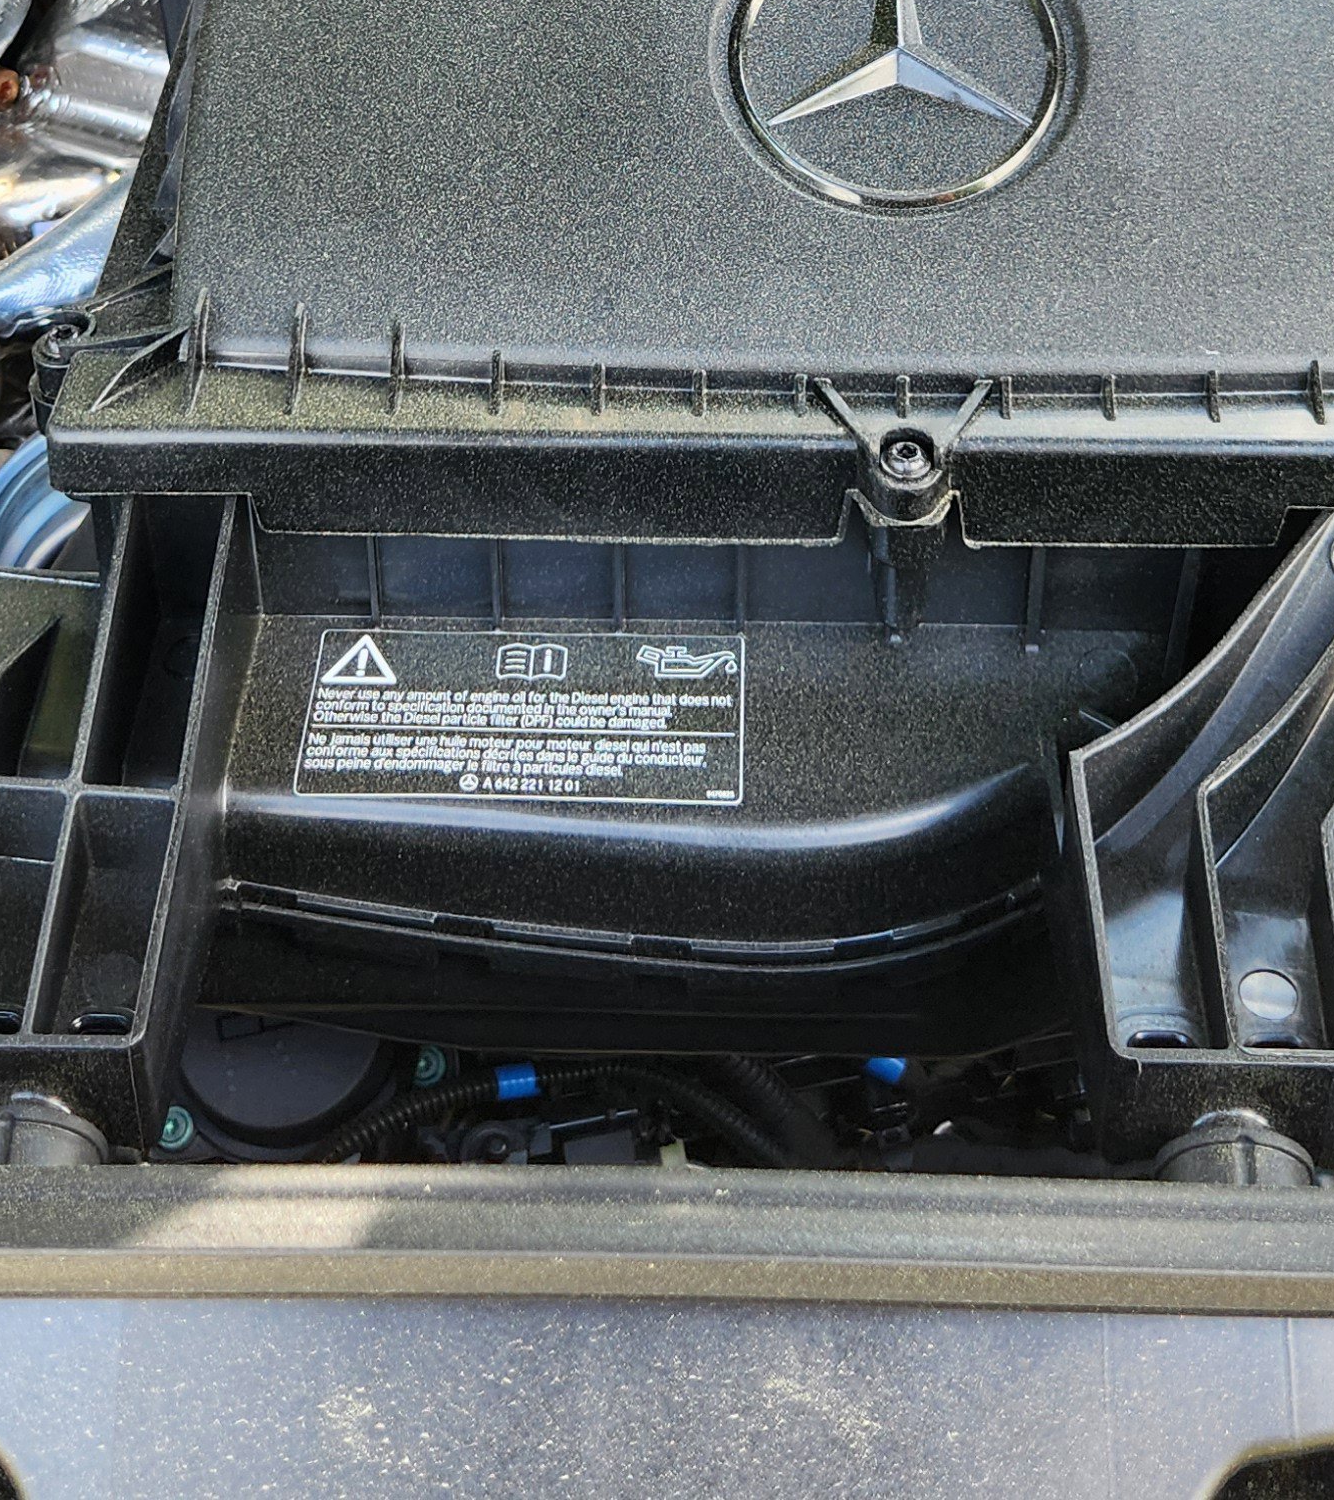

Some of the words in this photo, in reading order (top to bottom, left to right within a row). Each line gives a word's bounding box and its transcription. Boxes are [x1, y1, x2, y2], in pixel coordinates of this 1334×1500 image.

[318, 688, 355, 700] Never
[358, 690, 380, 700] use
[383, 691, 404, 703] any
[407, 690, 451, 701] amount
[453, 689, 468, 702] of
[470, 691, 510, 704] engine
[511, 691, 524, 703] oil
[528, 691, 546, 703] for
[550, 691, 570, 704] the
[573, 691, 608, 705] Diesel
[610, 693, 649, 707] engine
[652, 692, 677, 706] that
[679, 693, 709, 706] does
[711, 694, 732, 707] not
[315, 700, 369, 712] conform
[371, 701, 385, 712] to
[388, 701, 464, 715] specification
[466, 702, 542, 716] documented
[556, 703, 577, 716] the
[579, 704, 626, 717] owner's
[313, 711, 378, 723] Otherwise
[381, 711, 401, 723] the
[403, 712, 440, 725] Diesel
[441, 713, 487, 727] particle
[489, 714, 518, 727] filter
[520, 714, 553, 729] (DPF)
[556, 715, 588, 728] could
[590, 716, 606, 728] be
[308, 732, 327, 744] Ne
[373, 733, 414, 746] utiliser
[415, 735, 438, 746] une
[440, 734, 466, 747] huile
[468, 736, 514, 748] moteur
[516, 738, 543, 751] pour
[547, 738, 591, 751] moteur
[594, 738, 630, 752] diesel
[632, 740, 650, 754] qui
[652, 741, 681, 753] n'est
[684, 743, 706, 756] pas
[306, 746, 368, 758] conforme
[370, 747, 393, 758] aux
[395, 745, 480, 760] spécifications
[482, 747, 533, 761] décrites
[536, 750, 565, 763] dans
[580, 751, 616, 766] guide
[618, 752, 633, 764] du
[303, 759, 335, 770] sous
[336, 759, 371, 771] peine
[373, 758, 466, 774] d'endommager
[481, 760, 509, 772] filtre
[522, 763, 583, 778] particules
[482, 778, 493, 791] A
[496, 779, 518, 791] 642
[521, 779, 543, 791] 221
